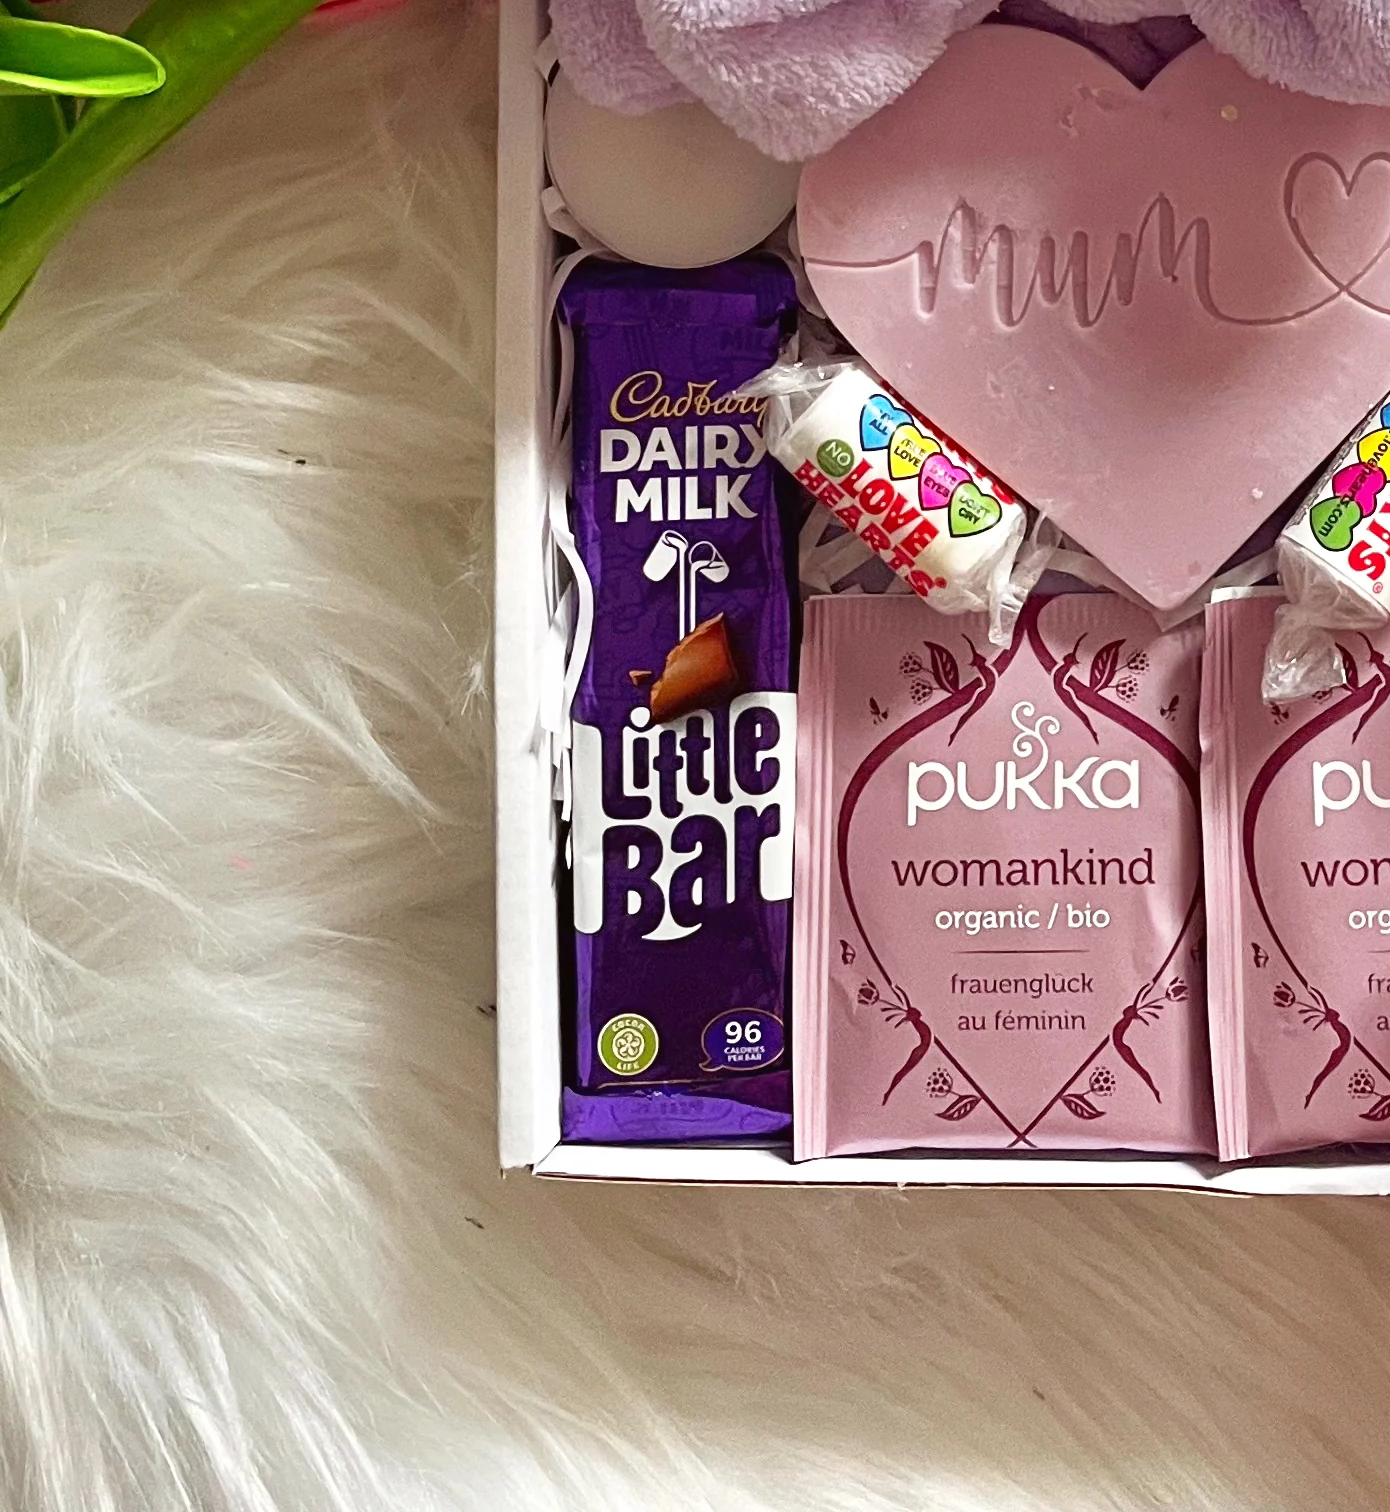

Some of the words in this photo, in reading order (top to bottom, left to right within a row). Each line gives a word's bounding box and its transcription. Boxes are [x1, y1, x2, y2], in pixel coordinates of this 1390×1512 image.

[609, 370, 769, 429] Cadbury
[600, 423, 768, 473] DAIRY
[825, 441, 851, 467] NO
[893, 445, 922, 468] LOVE
[614, 473, 759, 524] MILK
[923, 475, 951, 498] EYES
[838, 457, 940, 559] LOVE
[958, 507, 981, 525] CRY
[600, 705, 781, 821] Little
[906, 752, 1140, 828] pukka
[601, 802, 781, 936] Bar
[890, 847, 1156, 887] womankind
[934, 903, 1041, 936] organic
[1066, 901, 1111, 929] bio
[950, 972, 1095, 1000] frauenglück
[725, 1020, 762, 1044] 96
[957, 1014, 986, 1031] au
[994, 1008, 1087, 1031] féminin
[723, 1046, 766, 1055] CALORIES
[744, 1053, 762, 1061] BAR
